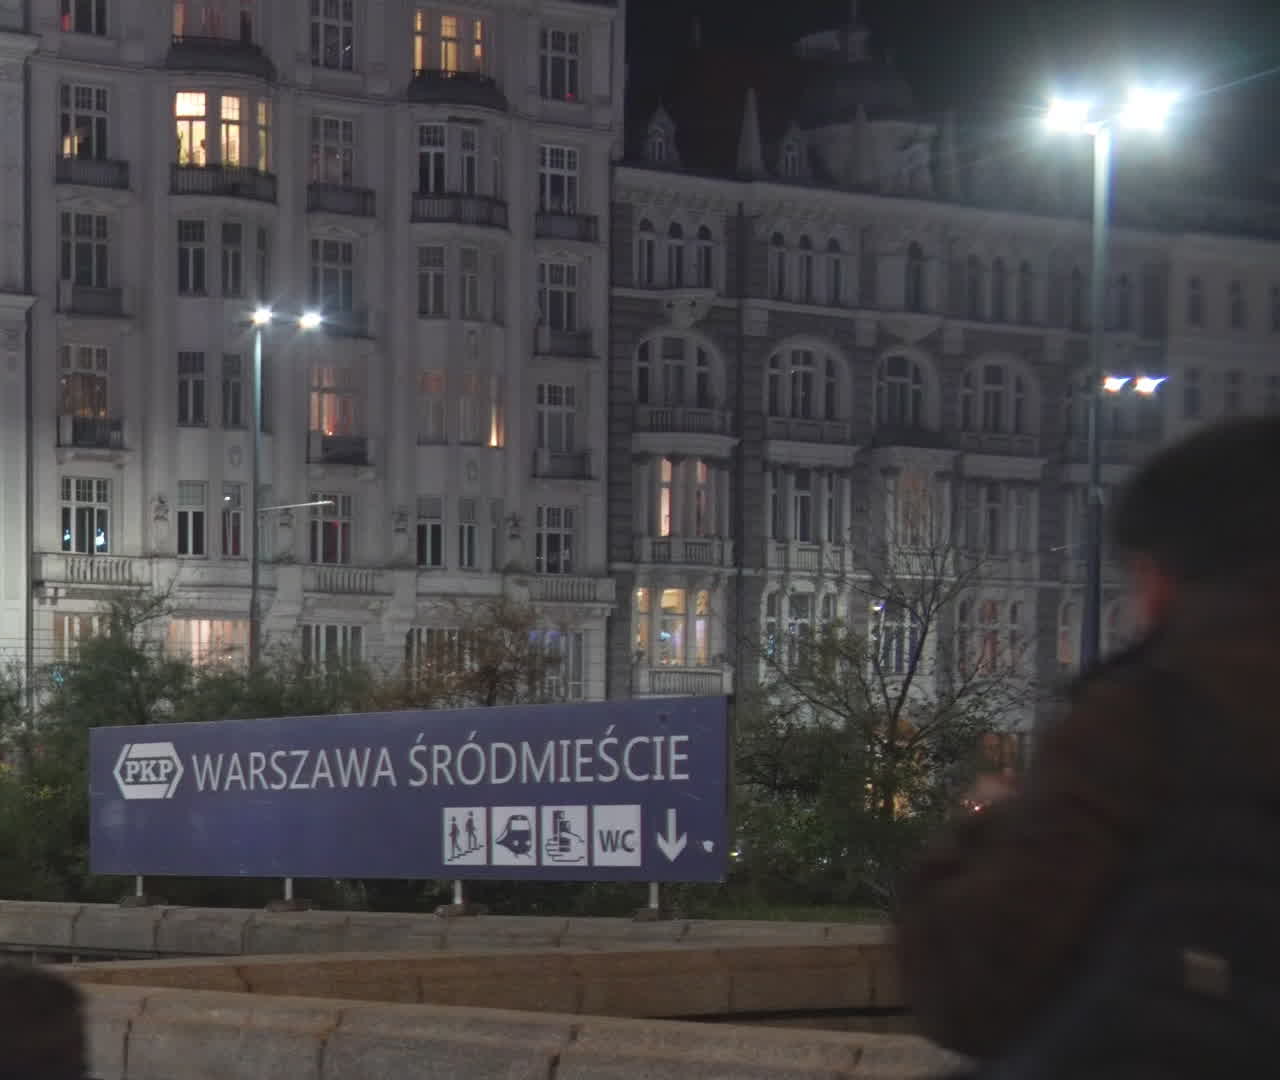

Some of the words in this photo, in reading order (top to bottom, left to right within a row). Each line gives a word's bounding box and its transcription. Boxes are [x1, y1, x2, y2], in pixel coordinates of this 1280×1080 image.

[191, 747, 397, 791] WARSZAWA
[408, 724, 689, 787] ŚRÓDMIEŚCIE
[124, 759, 174, 783] PKP
[598, 829, 636, 852] WC
